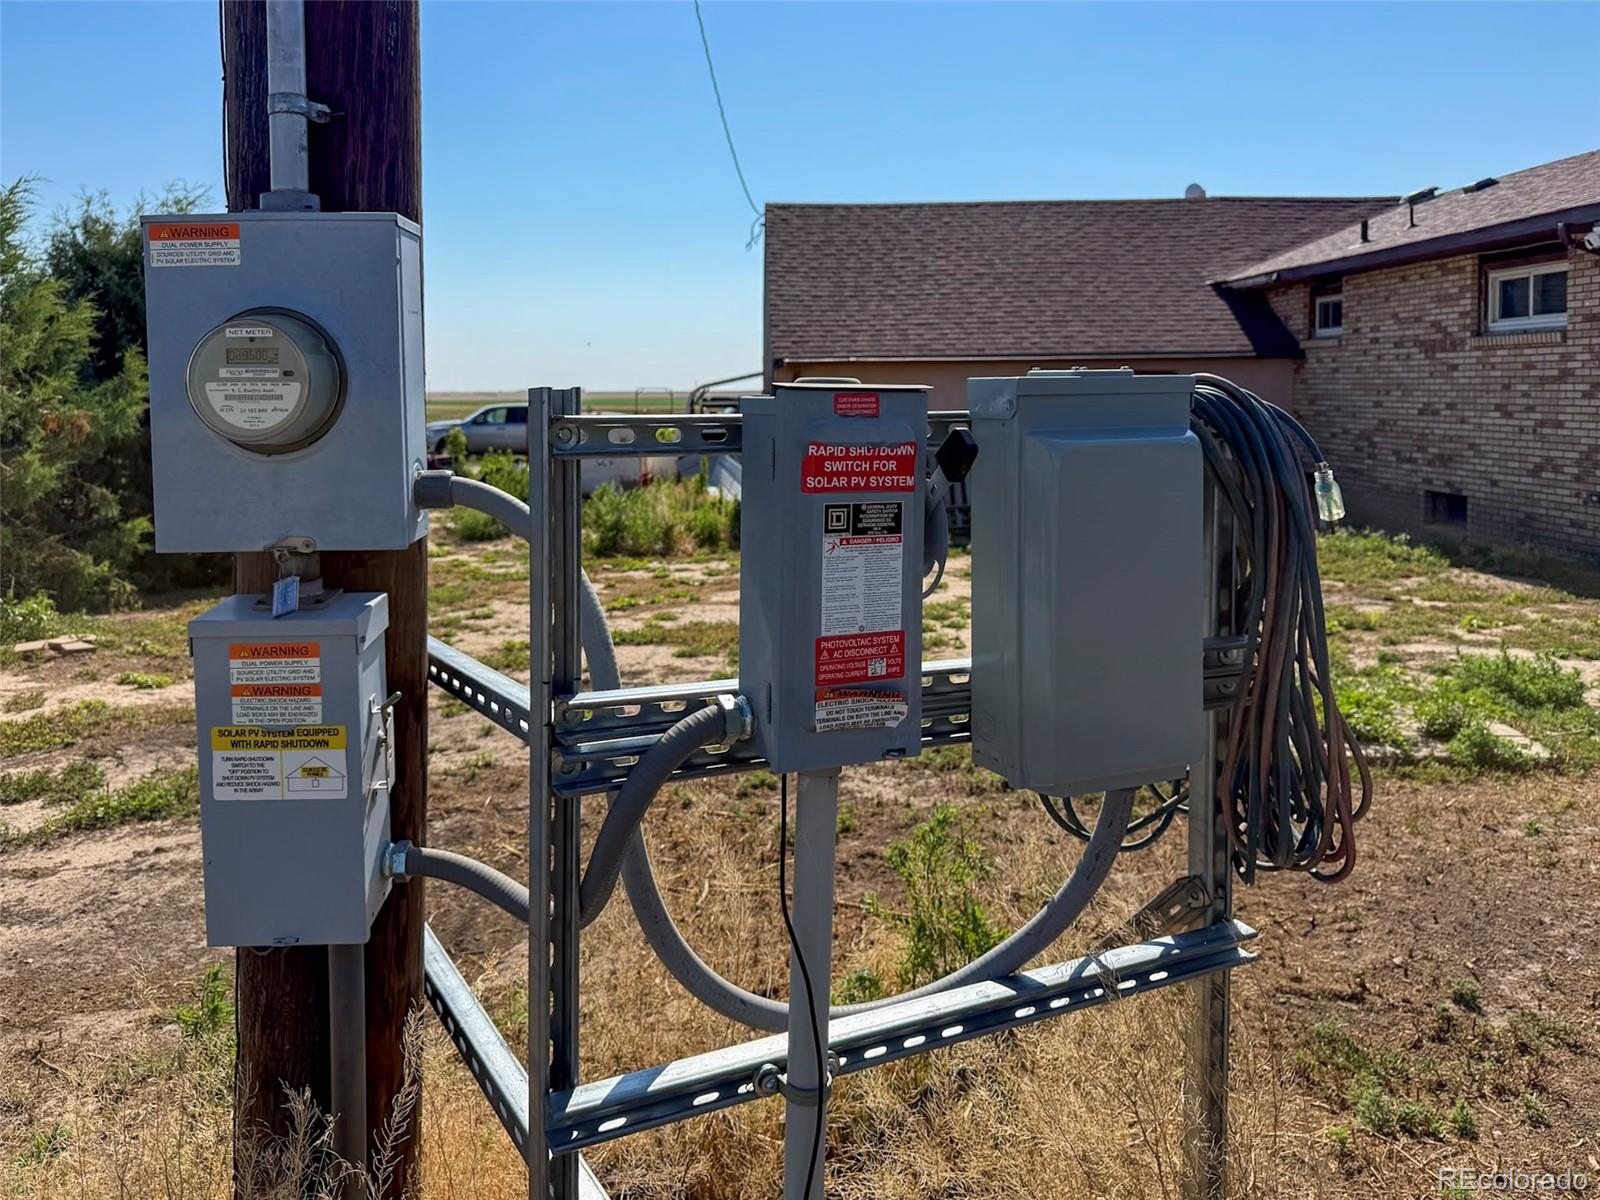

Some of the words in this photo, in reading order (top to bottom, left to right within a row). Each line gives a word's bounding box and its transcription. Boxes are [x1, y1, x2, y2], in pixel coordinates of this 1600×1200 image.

[170, 227, 229, 237] WARNING
[808, 445, 846, 457] RAPID
[849, 445, 915, 456] SHUTDOWN
[824, 460, 870, 472] SWITCH
[873, 460, 897, 471] FOR
[806, 476, 848, 488] SOLAR
[851, 476, 866, 487] PV
[869, 476, 914, 487] SYSTEM
[821, 637, 872, 650] PHOTOVOLTAIC
[873, 635, 900, 644] SYSTEM
[250, 647, 309, 656] WARNING
[833, 650, 843, 658] AC
[844, 646, 888, 657] DISCONNECT
[819, 663, 846, 672] OPERATING
[846, 661, 866, 669] VOLTAGE
[845, 670, 866, 678] CURRENT
[252, 686, 311, 696] WARNING
[817, 700, 850, 708] ELECTRIC
[817, 716, 845, 724] TERMINALS
[218, 729, 246, 737] SOLAR
[261, 729, 295, 738] SYSTEM
[297, 728, 339, 737] EQUIPPED
[230, 740, 251, 749] WITH
[253, 740, 279, 749] RAPID
[281, 740, 329, 748] SHUTDOWN
